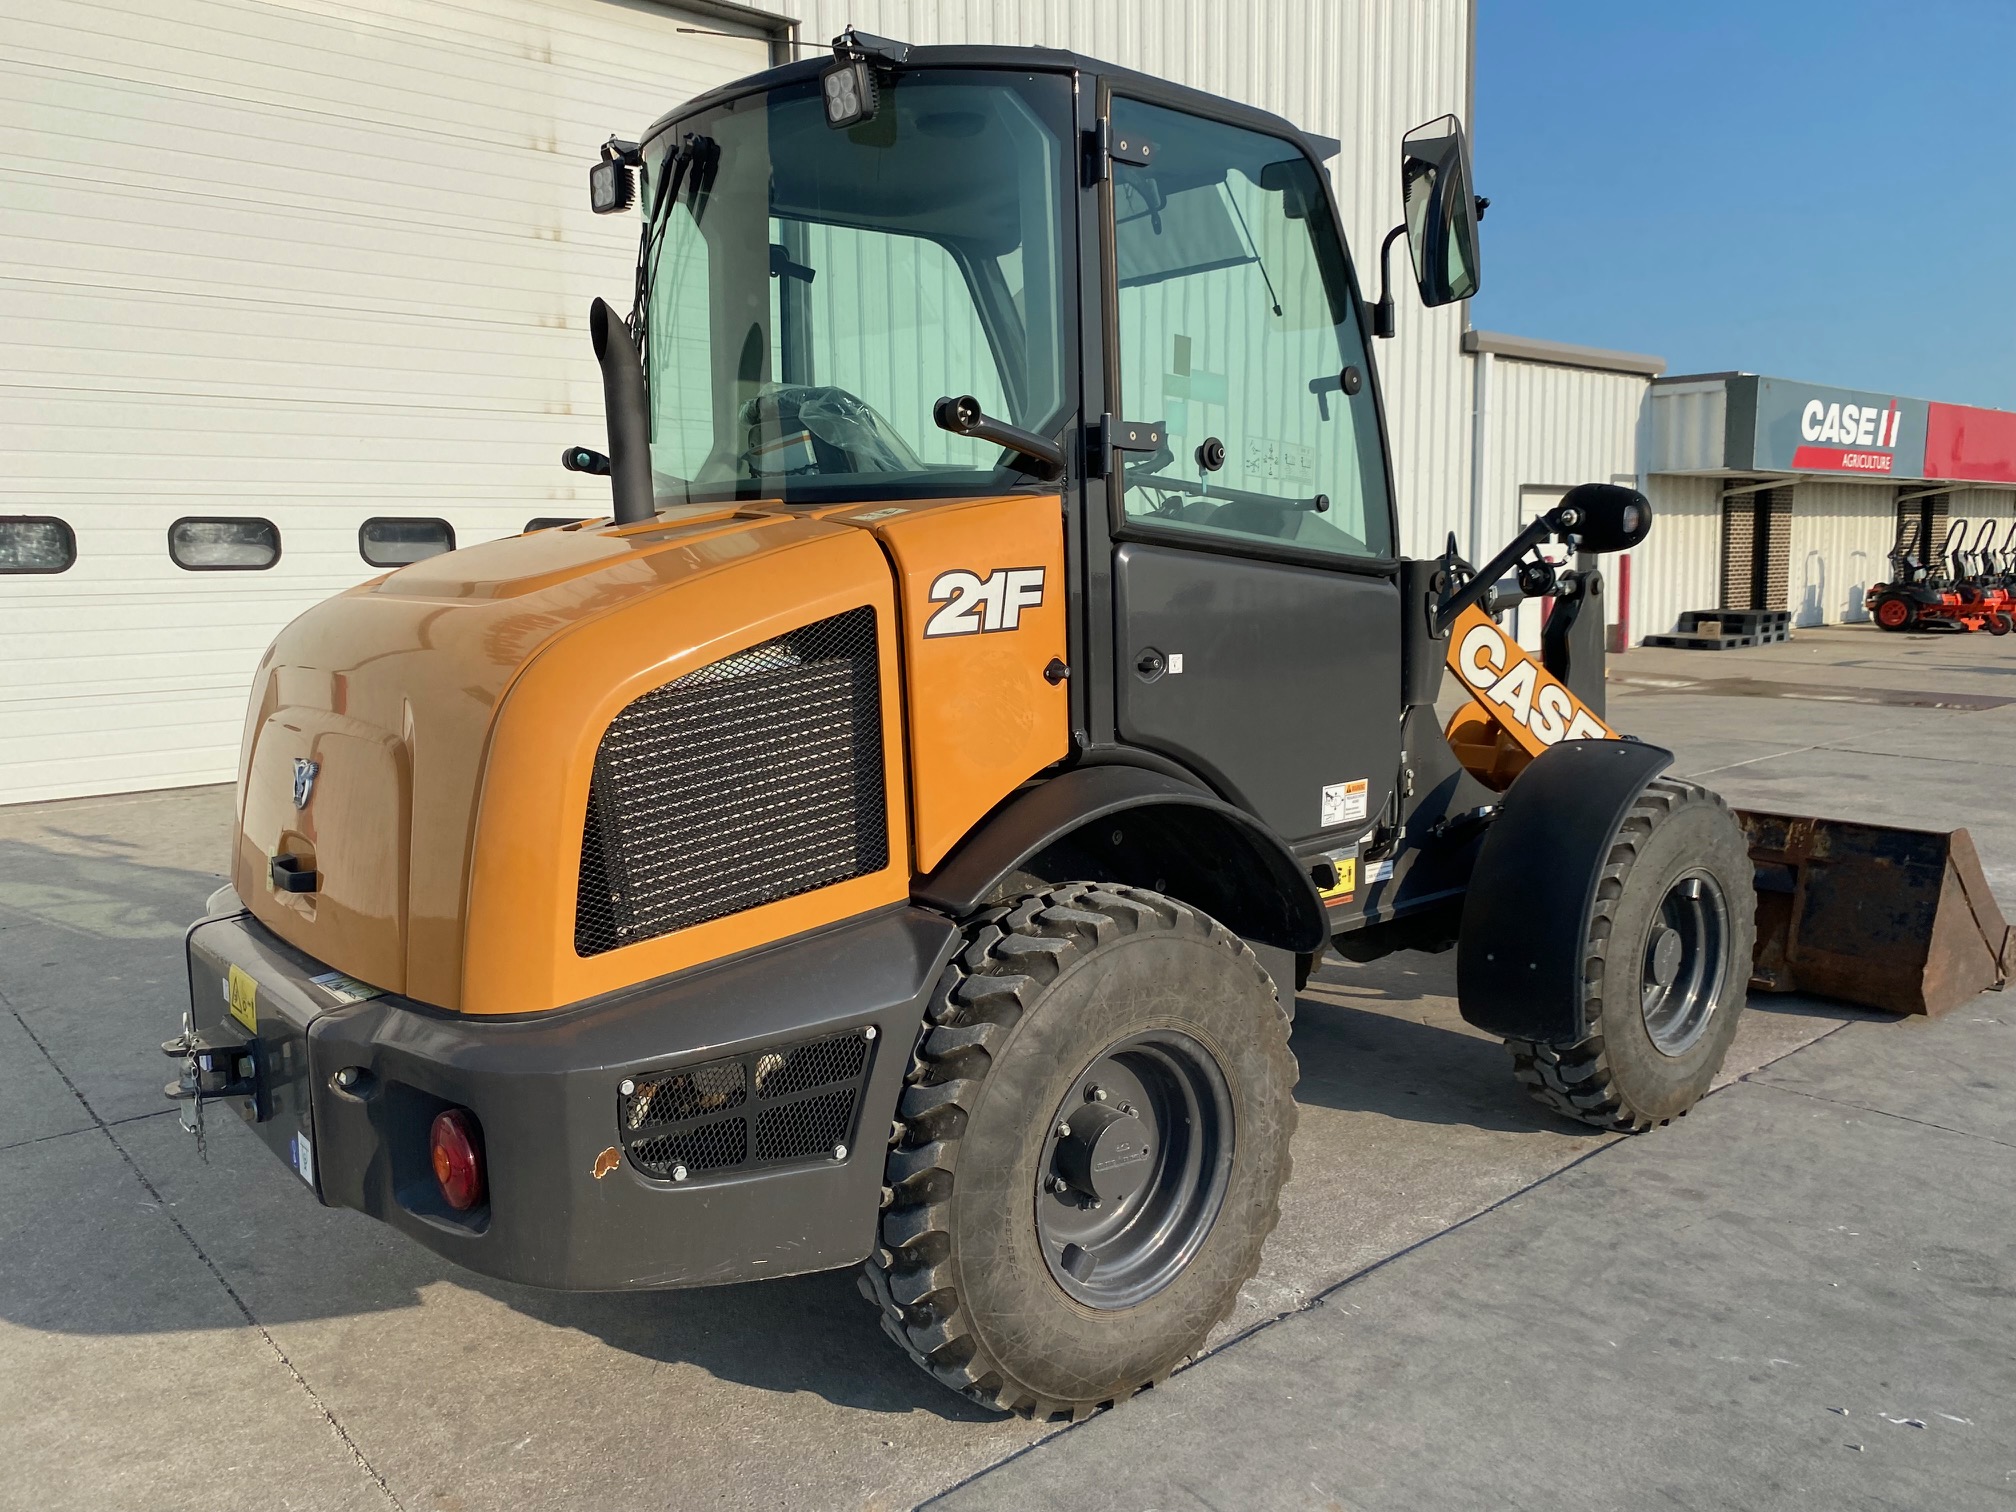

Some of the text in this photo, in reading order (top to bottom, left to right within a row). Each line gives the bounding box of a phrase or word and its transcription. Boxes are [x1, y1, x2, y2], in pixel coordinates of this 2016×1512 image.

[1801, 399, 1878, 446] CASE
[1842, 453, 1892, 470] AGRICULTURE
[924, 566, 1046, 639] 21F
